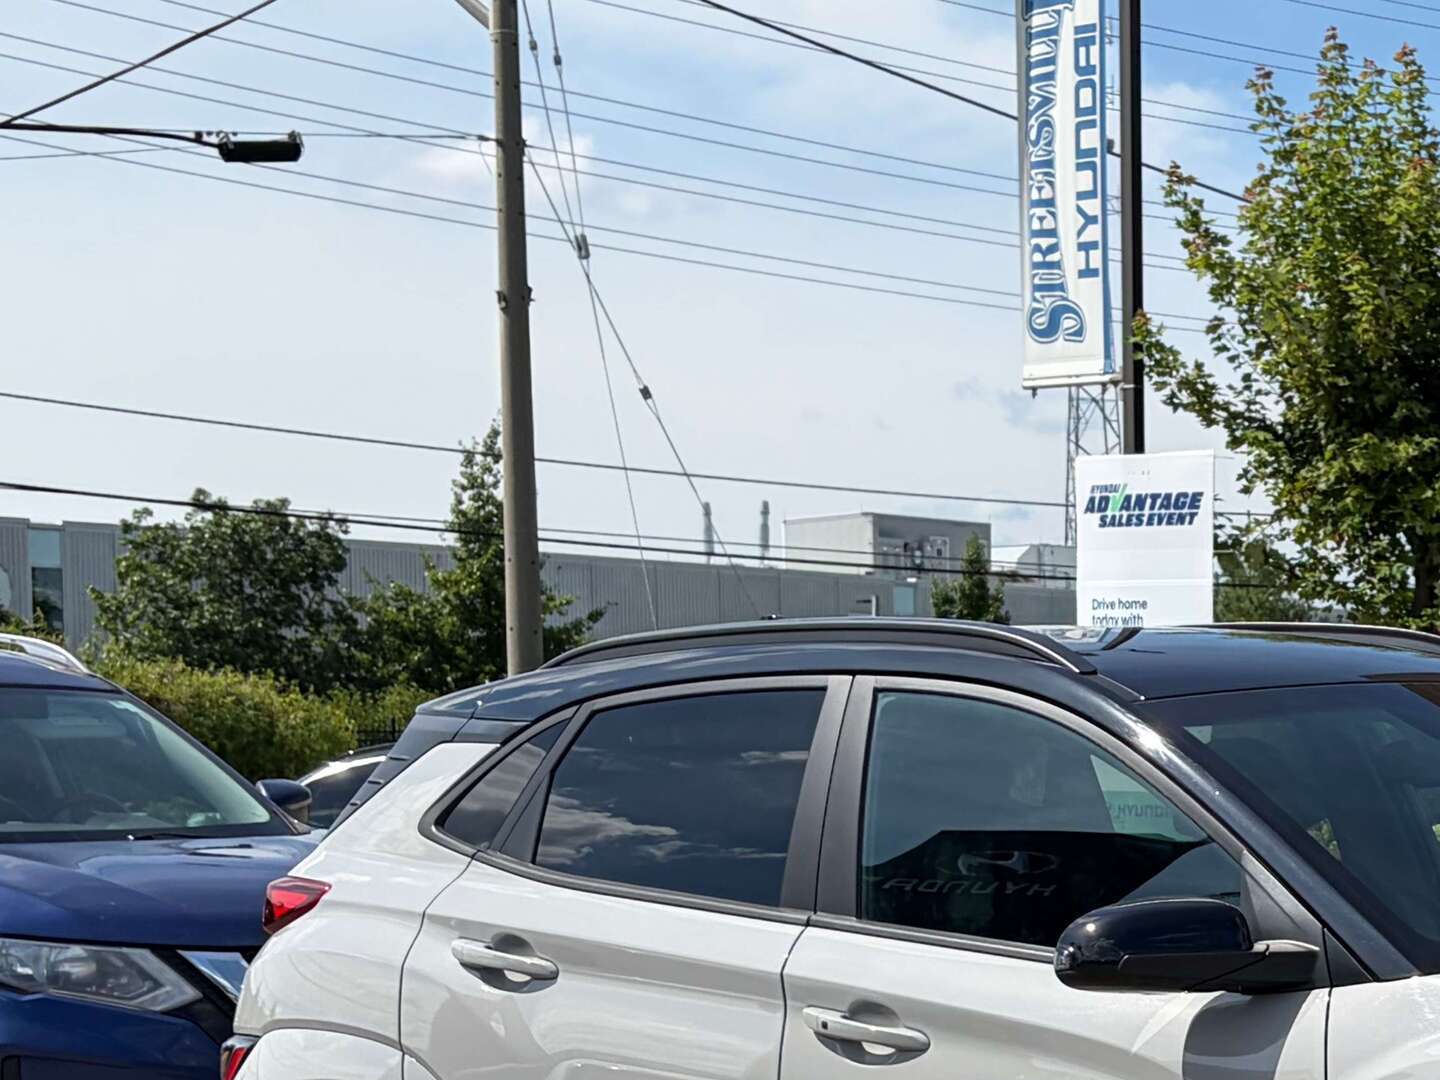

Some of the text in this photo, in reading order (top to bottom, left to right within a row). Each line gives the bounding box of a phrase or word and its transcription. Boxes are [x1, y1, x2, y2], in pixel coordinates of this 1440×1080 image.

[1073, 22, 1101, 280] HYUNDAI
[1023, 0, 1086, 343] STREETSVILL
[1084, 485, 1204, 514] ADVANTAGE
[1098, 511, 1199, 528] SALES EVENT
[1092, 598, 1148, 611] Drive home
